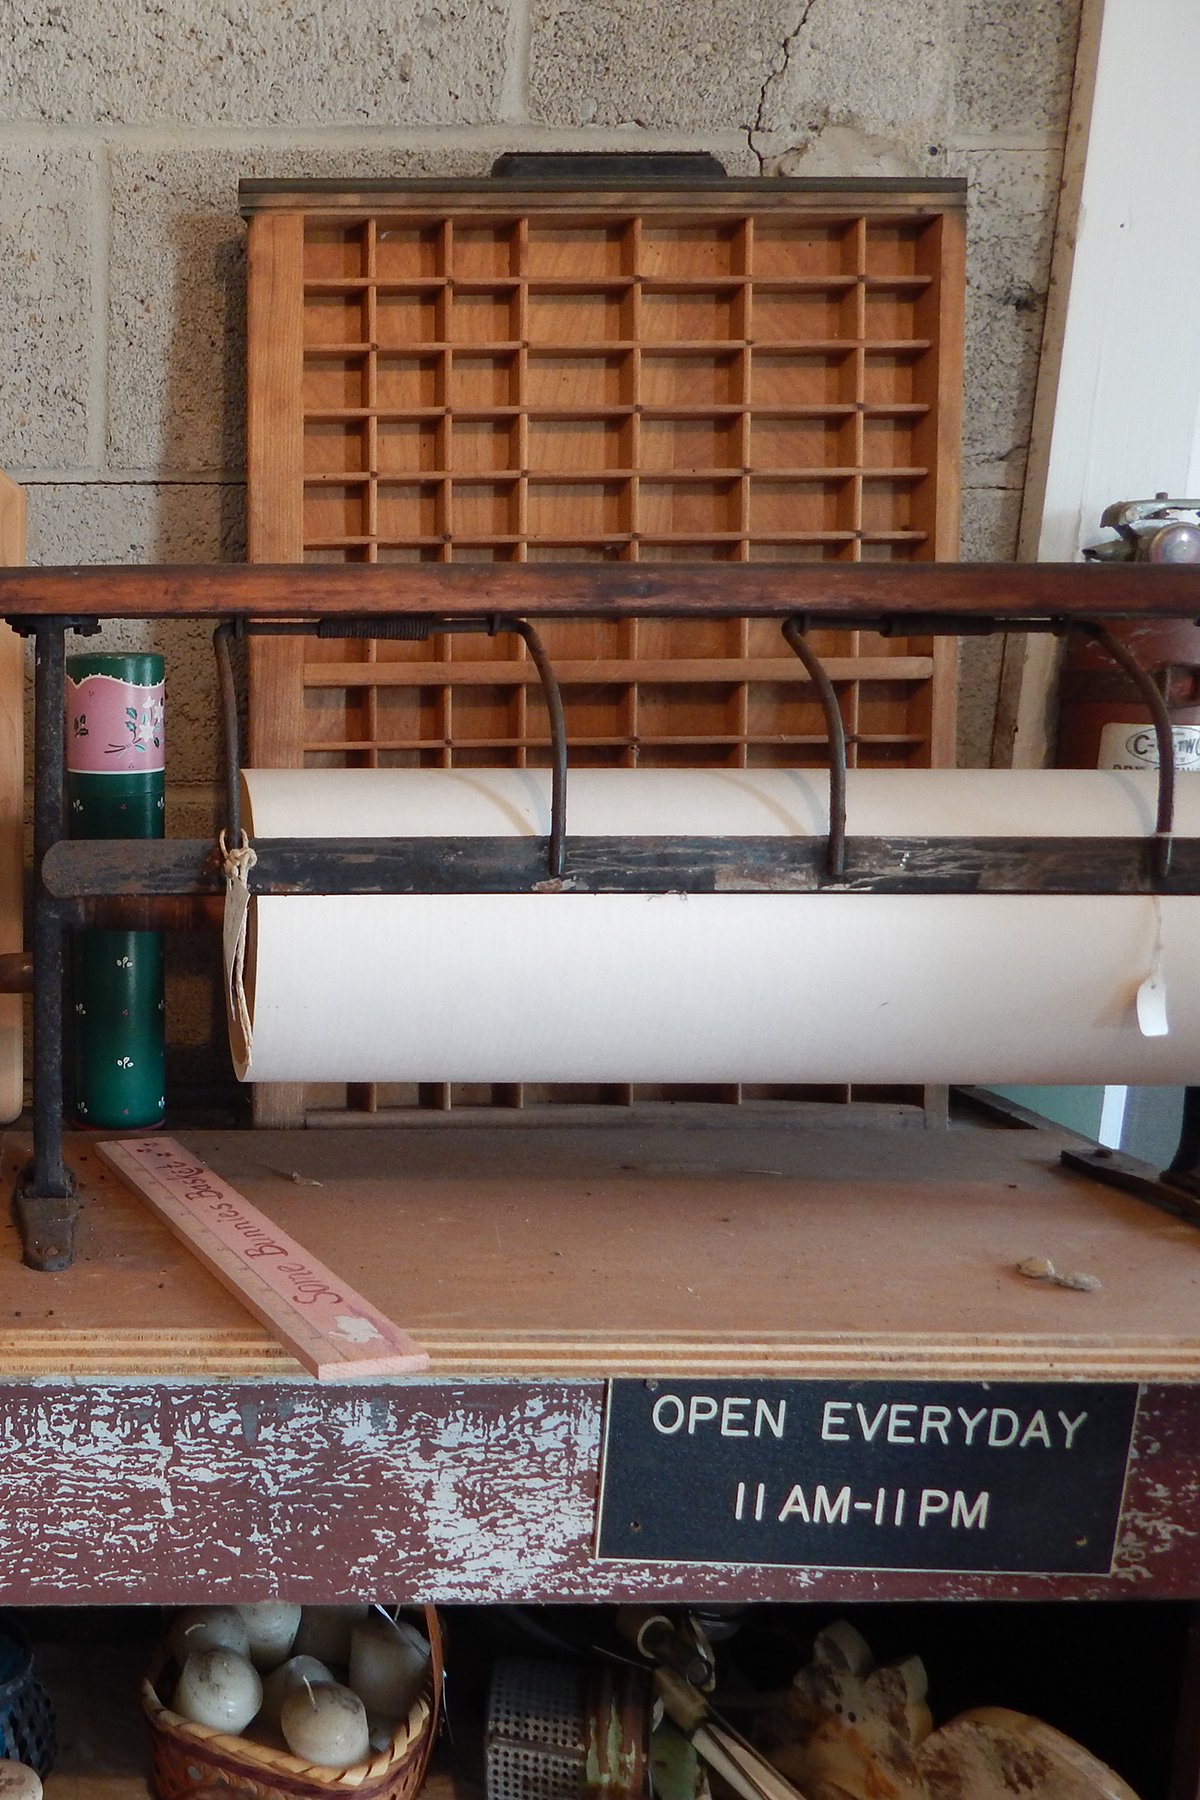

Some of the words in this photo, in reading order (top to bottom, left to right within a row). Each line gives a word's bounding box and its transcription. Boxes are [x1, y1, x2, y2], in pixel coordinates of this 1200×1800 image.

[210, 1203, 289, 1260] Bunnies
[277, 1263, 344, 1306] Some
[652, 1394, 787, 1438] OPEN
[821, 1401, 1089, 1450] EVERYDAY
